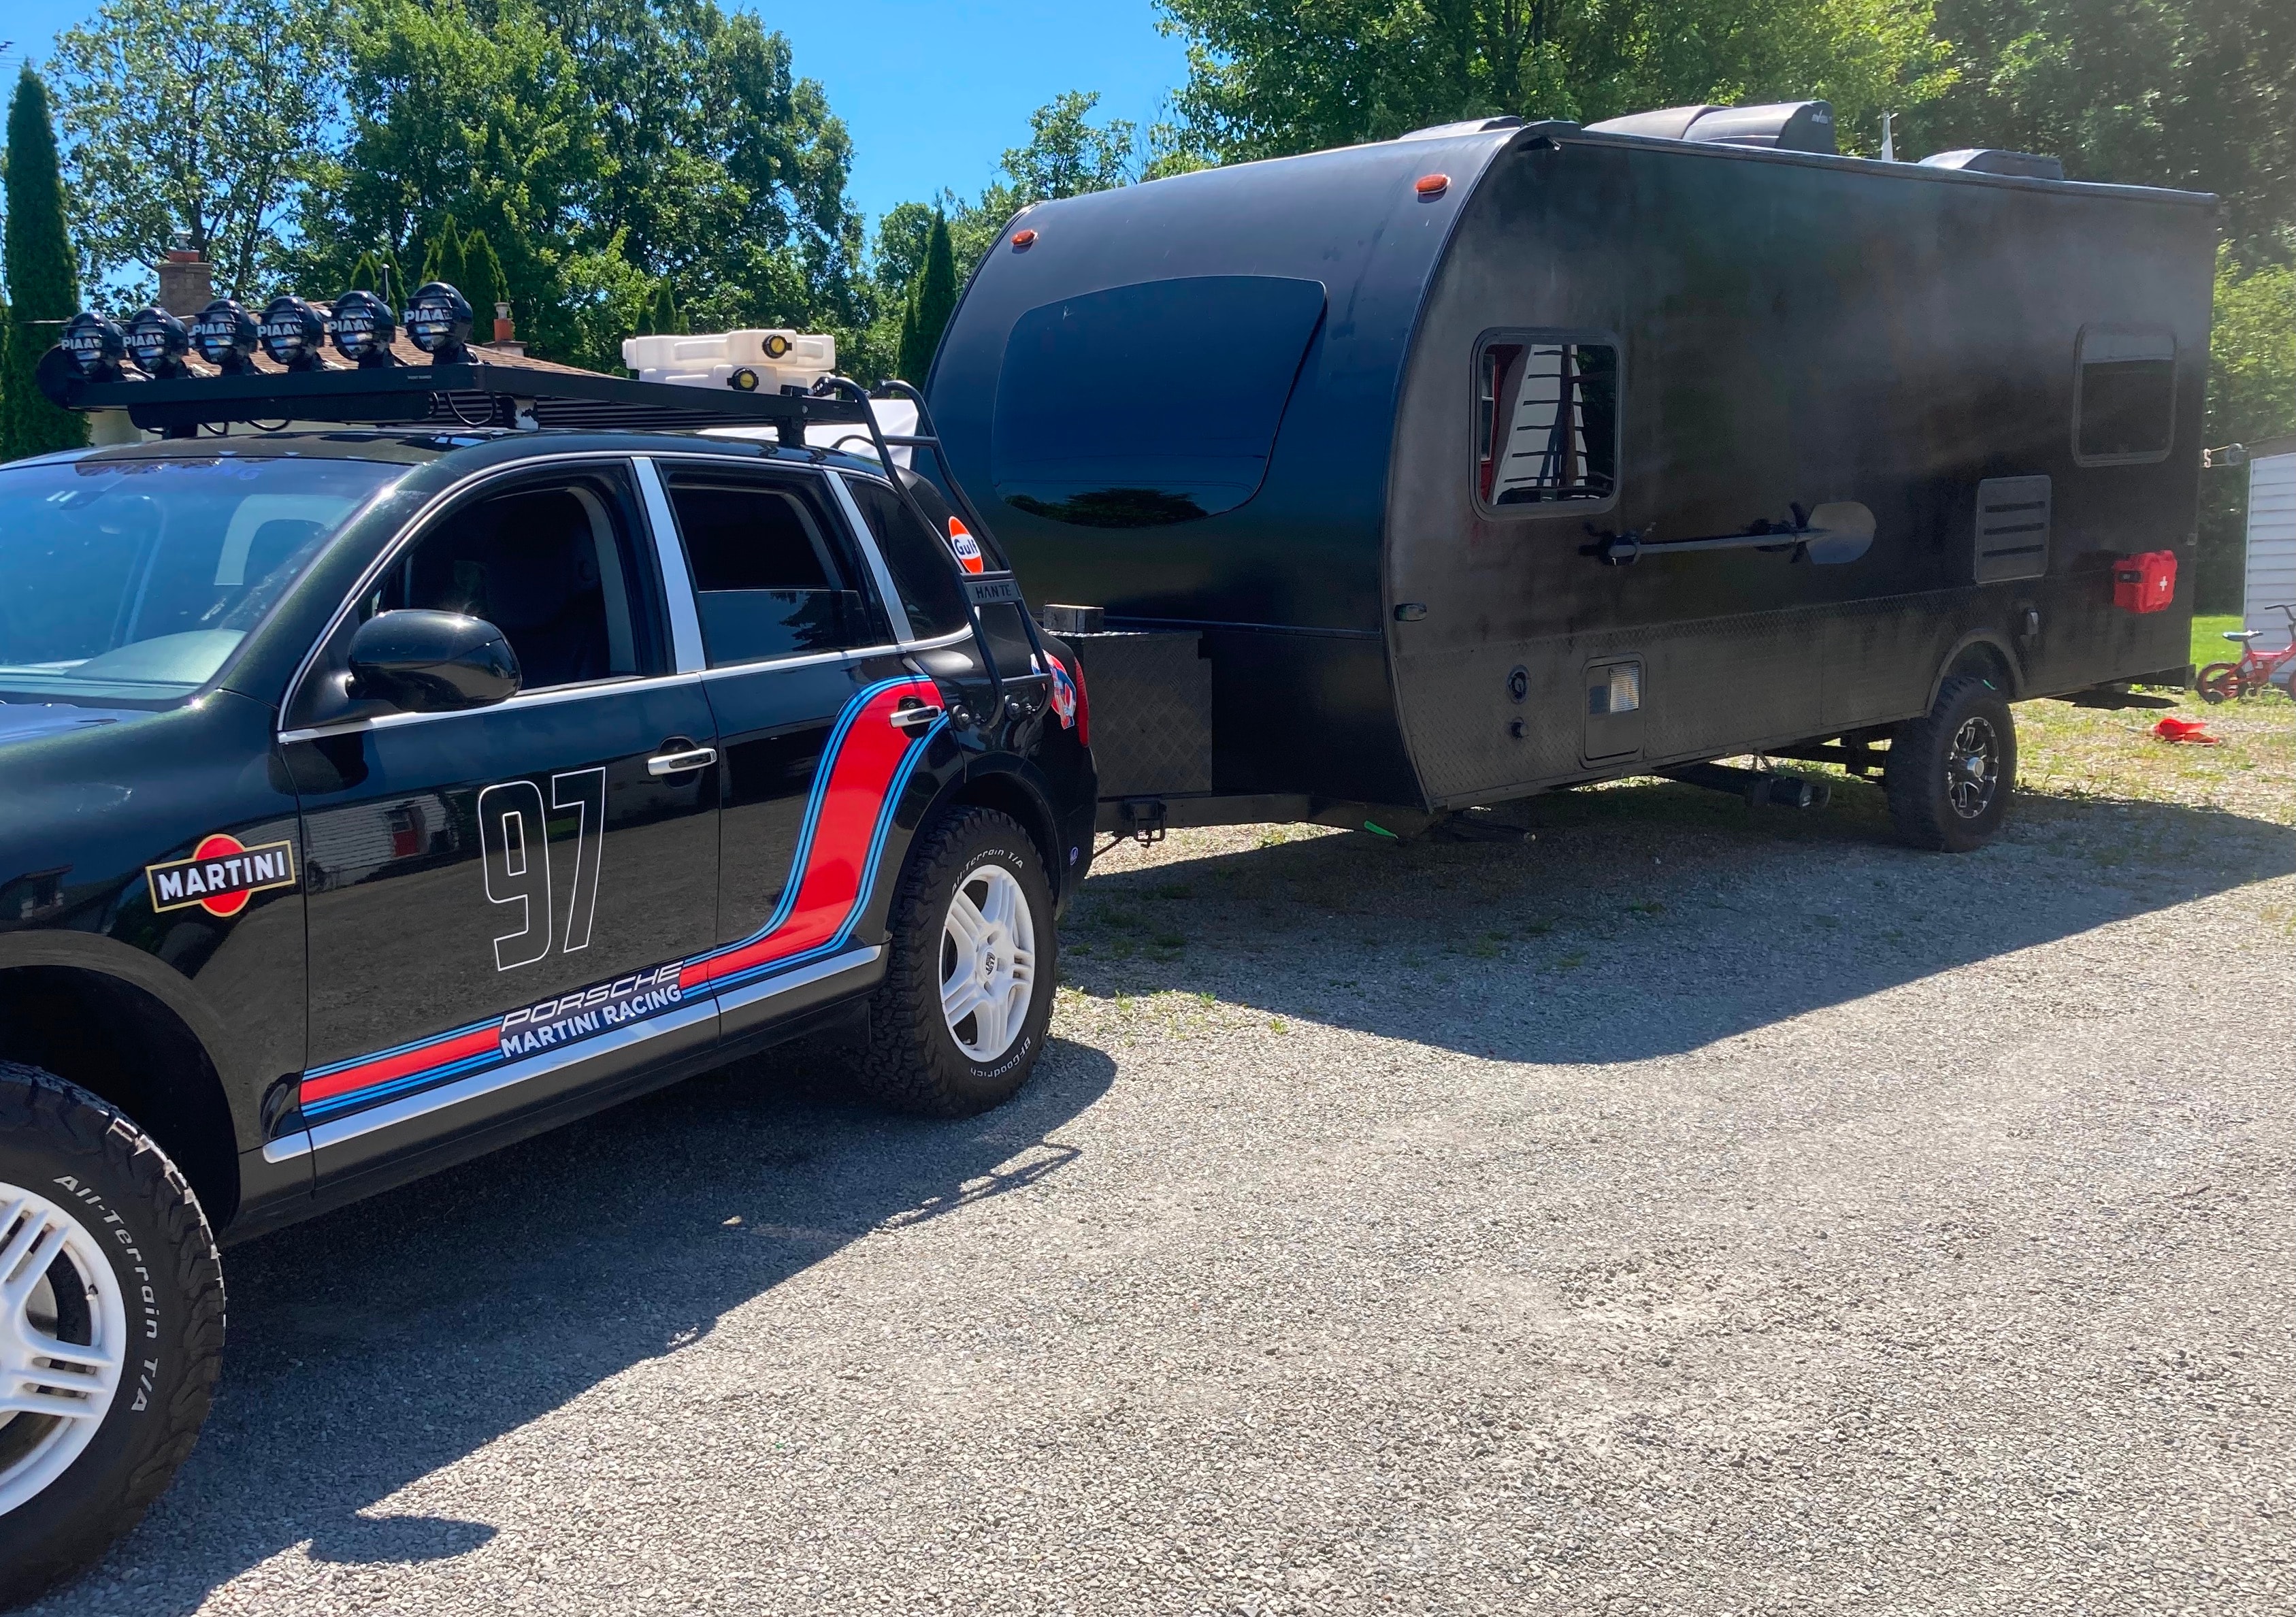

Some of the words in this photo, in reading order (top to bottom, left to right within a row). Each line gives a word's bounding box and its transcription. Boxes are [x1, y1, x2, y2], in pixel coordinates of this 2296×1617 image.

[404, 308, 444, 323] PIAA
[193, 323, 227, 336] PIAA
[257, 323, 295, 338] PIAA
[329, 318, 365, 332] PIAA
[61, 338, 95, 350] PIAA
[122, 334, 157, 348] PIAA
[953, 538, 979, 555] Gulf
[1008, 851, 1023, 869] T/A
[158, 851, 286, 901] MARTINI
[478, 766, 606, 972] 97
[501, 960, 684, 1032] PORSCHE
[500, 1011, 600, 1058] MARTINI
[602, 983, 682, 1025] RACING
[970, 1036, 1031, 1078] BFGoodrich
[53, 1175, 160, 1339] All-Terrain
[131, 1358, 159, 1411] T/A
